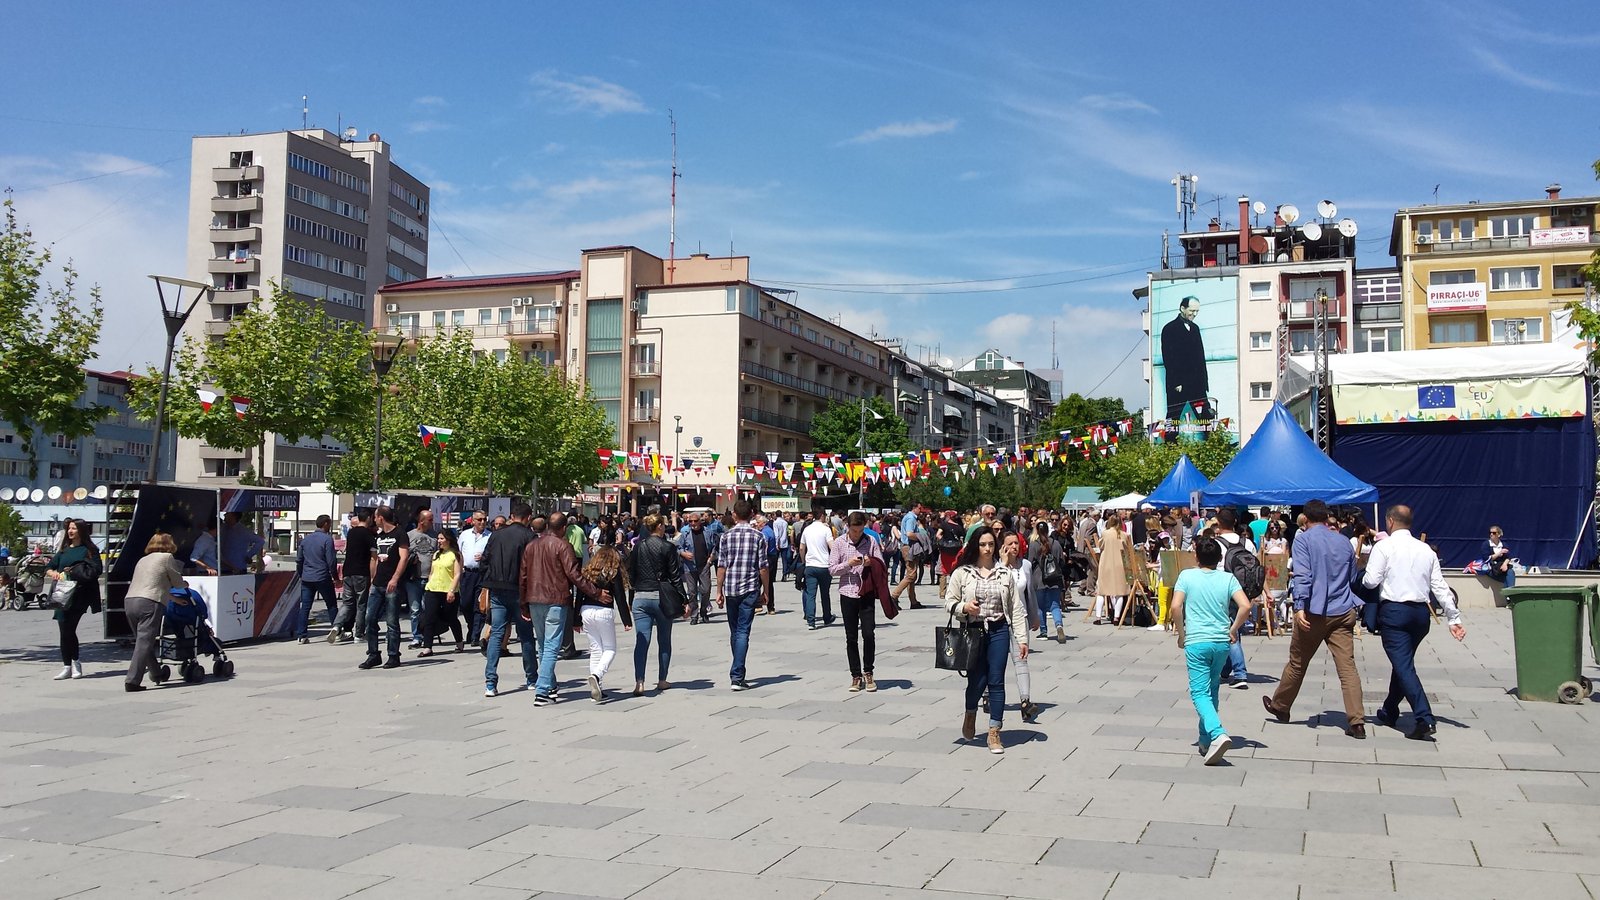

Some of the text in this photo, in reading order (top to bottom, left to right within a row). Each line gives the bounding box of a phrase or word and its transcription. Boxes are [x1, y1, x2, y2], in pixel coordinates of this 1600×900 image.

[1430, 290, 1480, 300] PIRRAÇI-U6
[1473, 391, 1488, 400] EU
[254, 494, 297, 508] NETHERLANDS
[763, 501, 785, 509] EUROPE
[785, 501, 796, 509] DAY
[236, 601, 248, 615] EU
